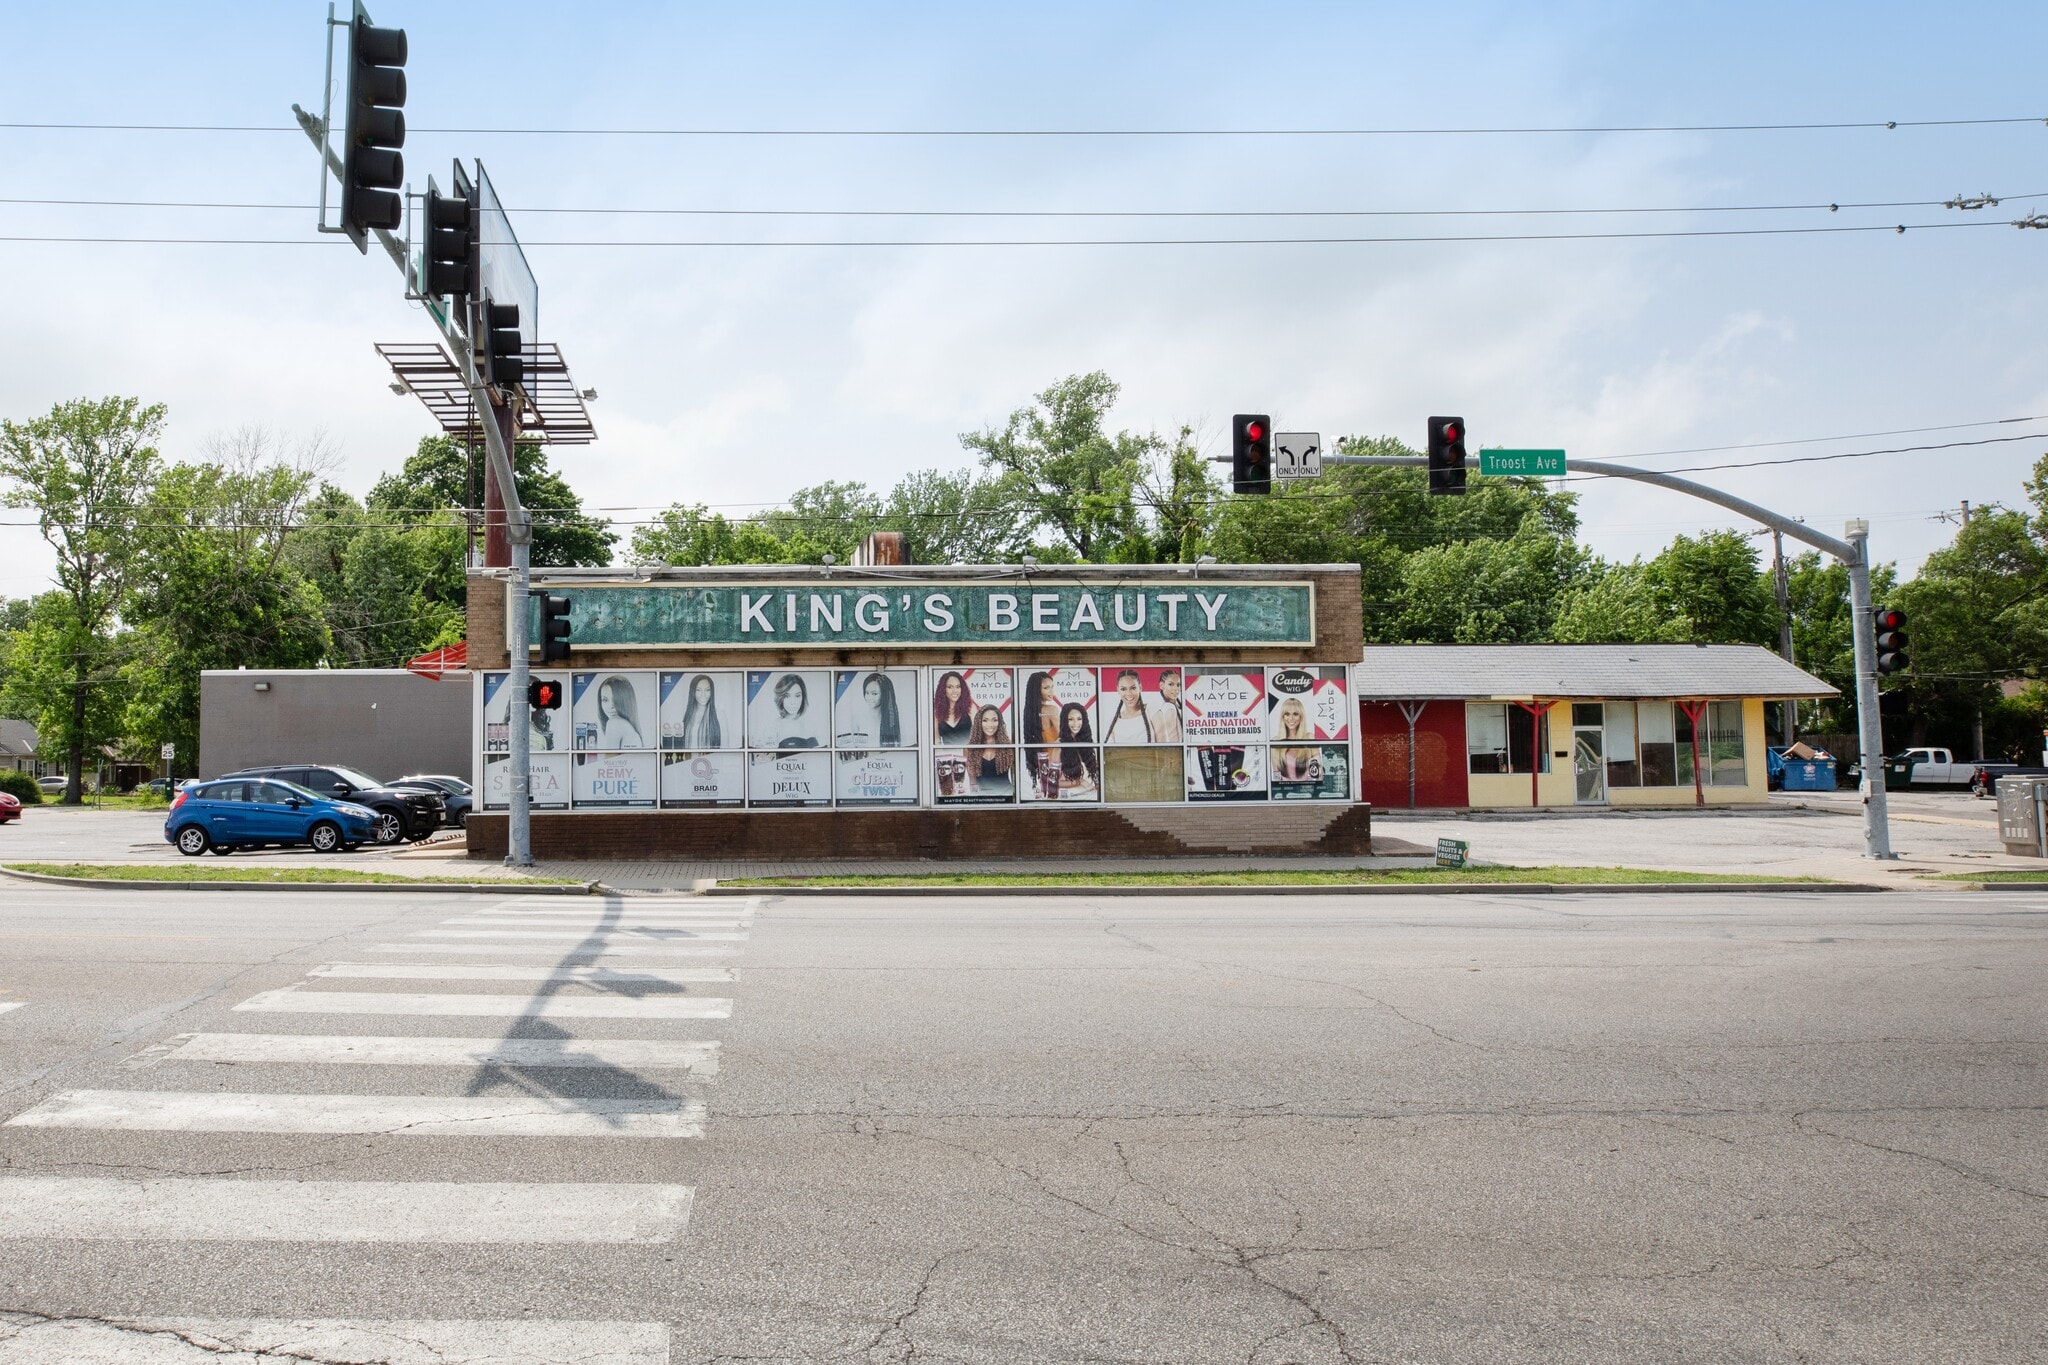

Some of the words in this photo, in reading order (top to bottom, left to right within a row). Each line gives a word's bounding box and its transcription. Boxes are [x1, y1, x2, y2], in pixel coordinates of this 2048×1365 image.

[1489, 456, 1526, 469] Troost
[1536, 456, 1558, 469] Ave
[1300, 467, 1319, 475] ONLY
[740, 593, 955, 633] KING'S
[988, 593, 1228, 632] BEAUTY
[1274, 673, 1312, 688] Candy
[1194, 692, 1248, 700] MAYDE
[1327, 689, 1336, 731] MAYDE
[1220, 718, 1257, 727] NATION
[1237, 726, 1262, 735] BRAIDS
[776, 762, 806, 772] EQUAL
[867, 761, 894, 770] EQUAL
[597, 768, 634, 779] REMY
[493, 775, 560, 791] SGA
[772, 782, 811, 796] DELUX
[862, 786, 897, 797] TWIST
